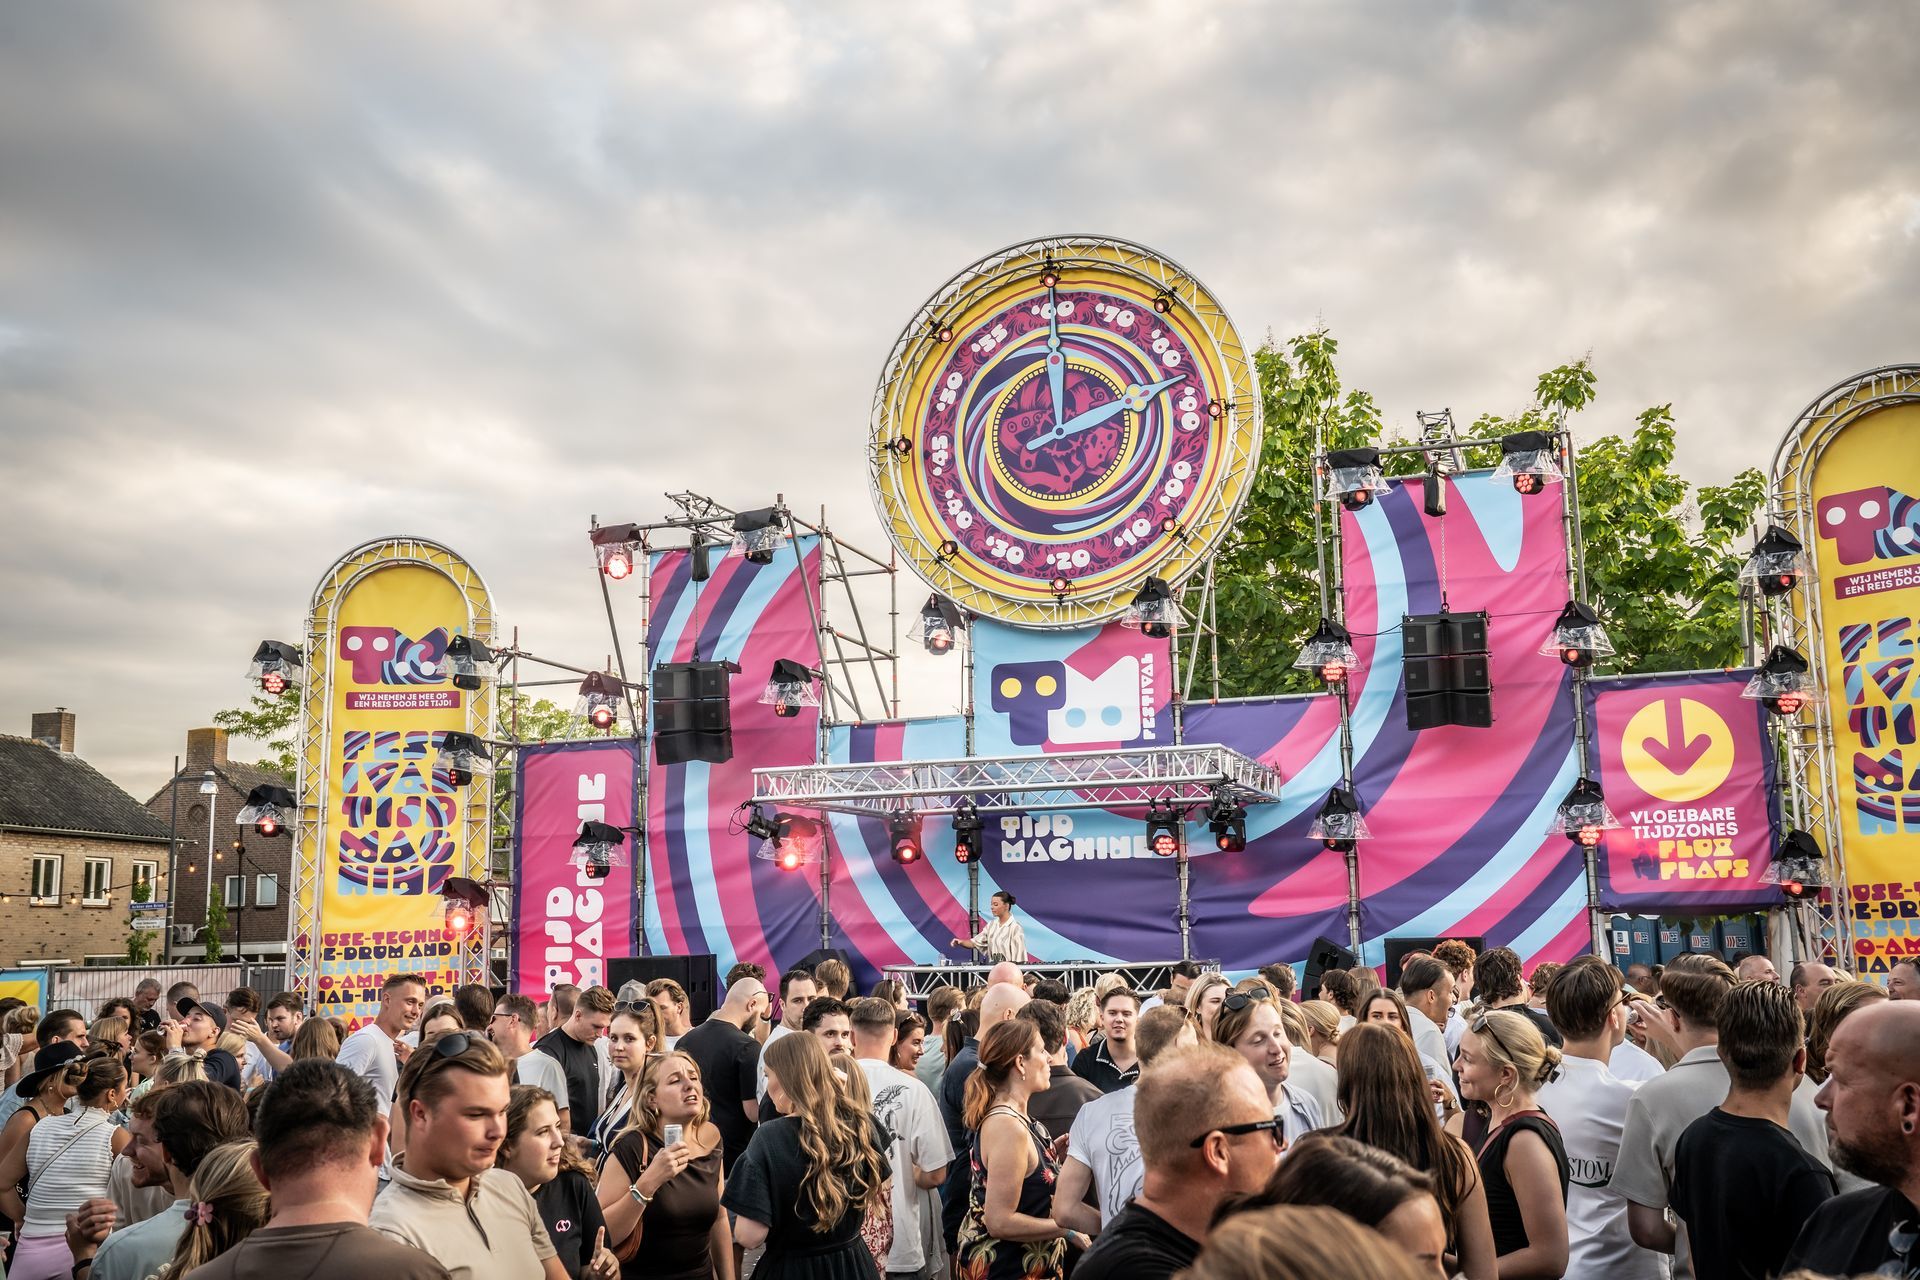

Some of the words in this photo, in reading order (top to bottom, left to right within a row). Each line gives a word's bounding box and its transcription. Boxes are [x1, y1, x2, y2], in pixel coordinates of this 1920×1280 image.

[1095, 302, 1135, 327] '70
[971, 323, 1008, 352] '55
[1151, 329, 1181, 367] '80
[936, 371, 963, 411] '50
[1179, 386, 1200, 431] '90
[931, 435, 948, 476] '45
[945, 489, 973, 529] '40
[1113, 518, 1151, 546] '10
[985, 536, 1024, 565] '30
[1046, 549, 1091, 570] '20
[1845, 586, 1865, 595] EEN
[1867, 580, 1893, 591] REIS
[1849, 574, 1871, 585] WIJ
[1873, 567, 1912, 581] NEMEN
[359, 693, 376, 701] WIJ
[418, 692, 434, 700] MEE
[431, 699, 452, 707] TIJD!
[1141, 653, 1156, 740] FESTIVAL
[342, 796, 457, 828] TIJD
[1000, 814, 1074, 838] TIJD
[1630, 807, 1736, 824] VLOEIBARE
[1631, 822, 1739, 839] TIJDZONES
[339, 830, 456, 863] MAC
[1001, 835, 1152, 863] MACHINE
[1658, 838, 1734, 859] FLUX
[1660, 859, 1749, 880] FLATS
[408, 942, 452, 958] AND
[544, 886, 574, 994] TIJD
